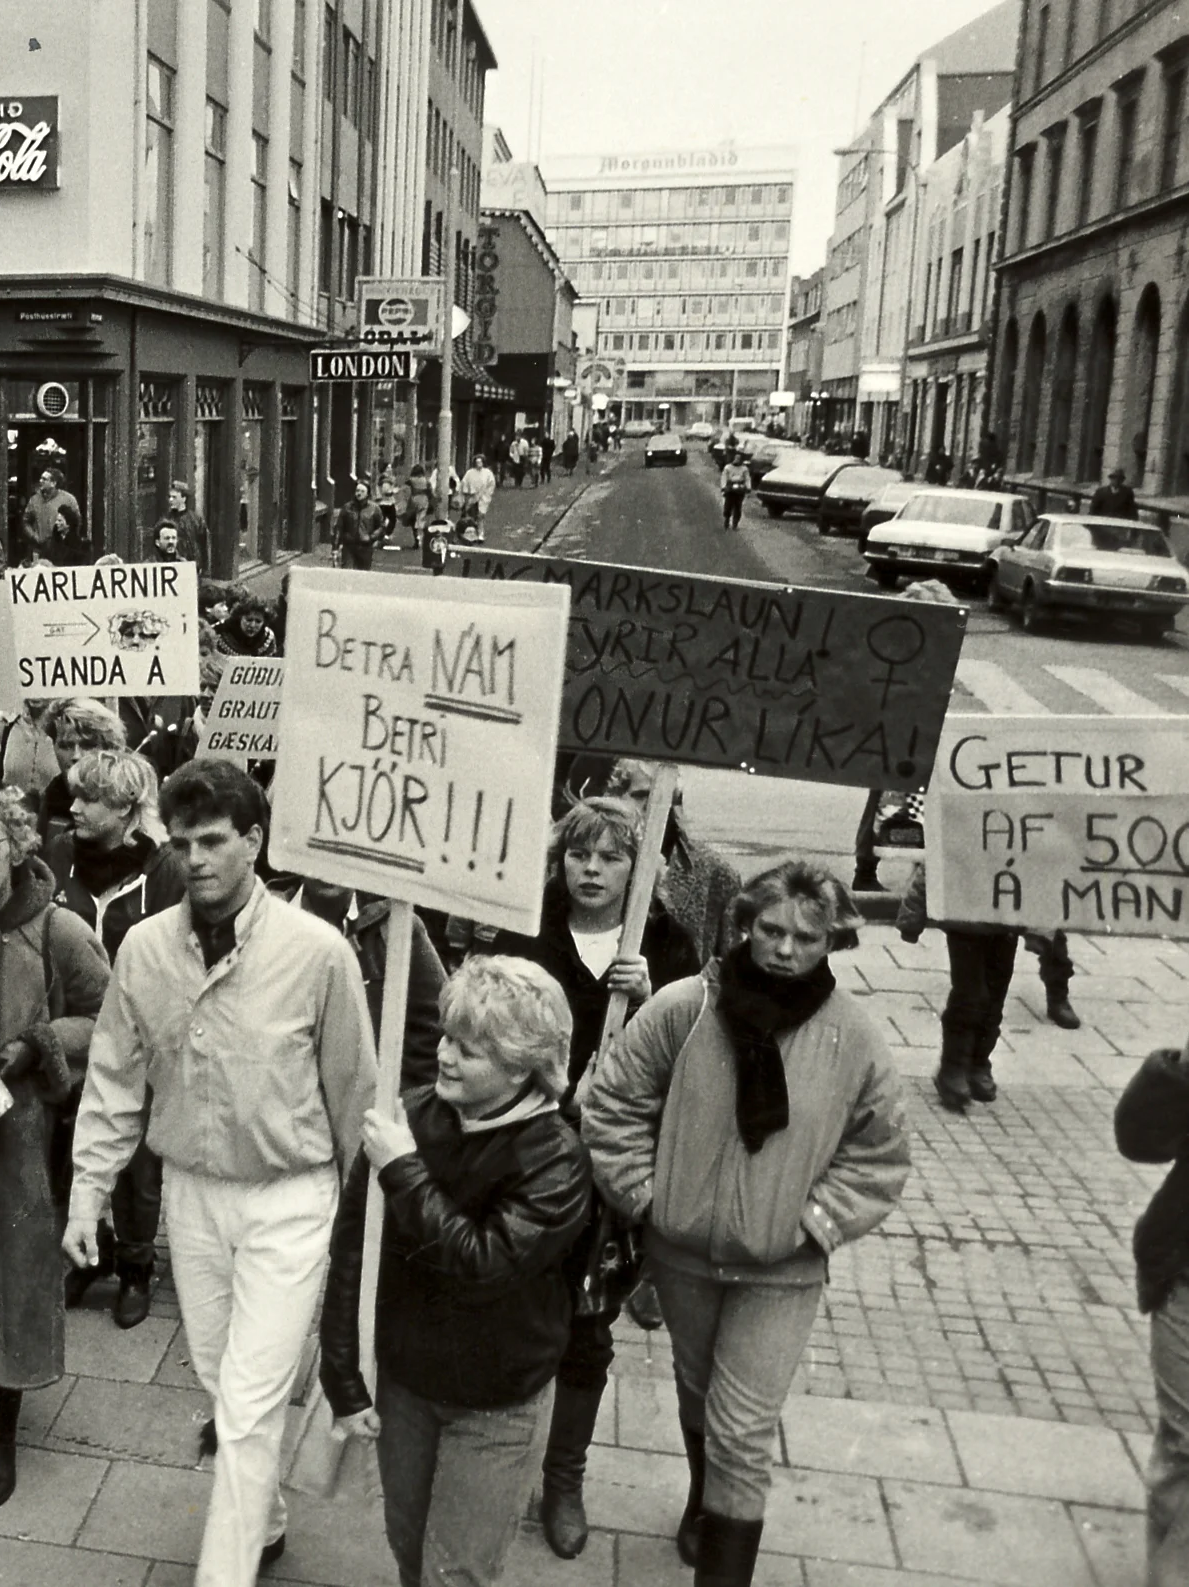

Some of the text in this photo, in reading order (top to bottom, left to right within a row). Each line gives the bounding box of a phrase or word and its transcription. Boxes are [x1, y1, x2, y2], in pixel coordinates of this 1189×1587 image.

[316, 354, 405, 378] LONDON
[11, 566, 178, 604] KARLARNIR
[315, 608, 415, 684] BETRA
[570, 614, 818, 688] YRIR ALLA
[19, 656, 126, 687] STANDA
[208, 731, 279, 752] GÆSKA
[568, 683, 729, 756] ONUR
[949, 735, 1148, 792] GETUR
[982, 809, 1055, 853] AF
[992, 857, 1022, 911] Á
